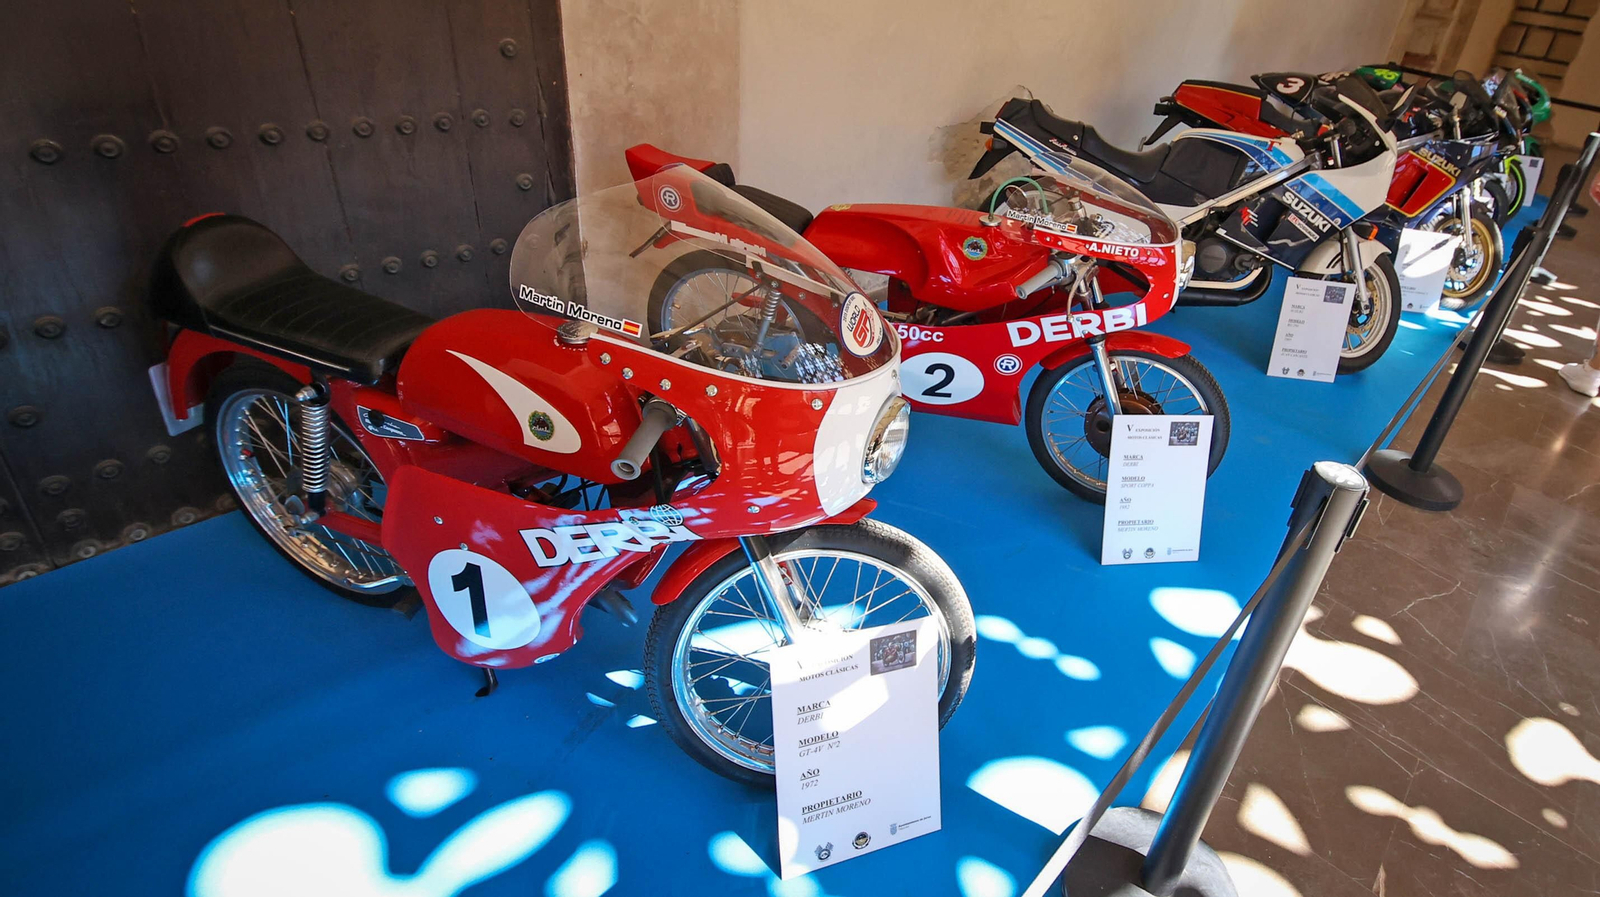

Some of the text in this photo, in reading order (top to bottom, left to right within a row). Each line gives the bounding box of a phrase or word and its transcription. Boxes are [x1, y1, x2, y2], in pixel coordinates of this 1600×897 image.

[1276, 77, 1305, 94] 3
[1419, 147, 1462, 177] SUZUKI
[1007, 210, 1067, 230] Martin Moreno
[1282, 191, 1332, 233] SUZUKI
[1088, 242, 1139, 257] A.NIETO
[520, 286, 622, 331] Martin Moreno
[847, 305, 860, 332] WORLD
[1006, 302, 1148, 348] DERBI
[897, 324, 944, 343] 50cc
[921, 363, 957, 398] 2
[1127, 424, 1134, 432] V
[519, 519, 704, 568] DERBI
[451, 562, 491, 638] 1
[799, 671, 825, 683] MOTOS
[797, 700, 831, 715] MARCA
[797, 712, 824, 725] DERBI
[798, 730, 839, 748] MODELO
[799, 744, 824, 757] GT-4V
[800, 768, 820, 780] AÑO
[801, 779, 819, 790] 1972
[801, 790, 863, 815] PROPIETARIO
[802, 798, 871, 824] MERTIN MORENO
